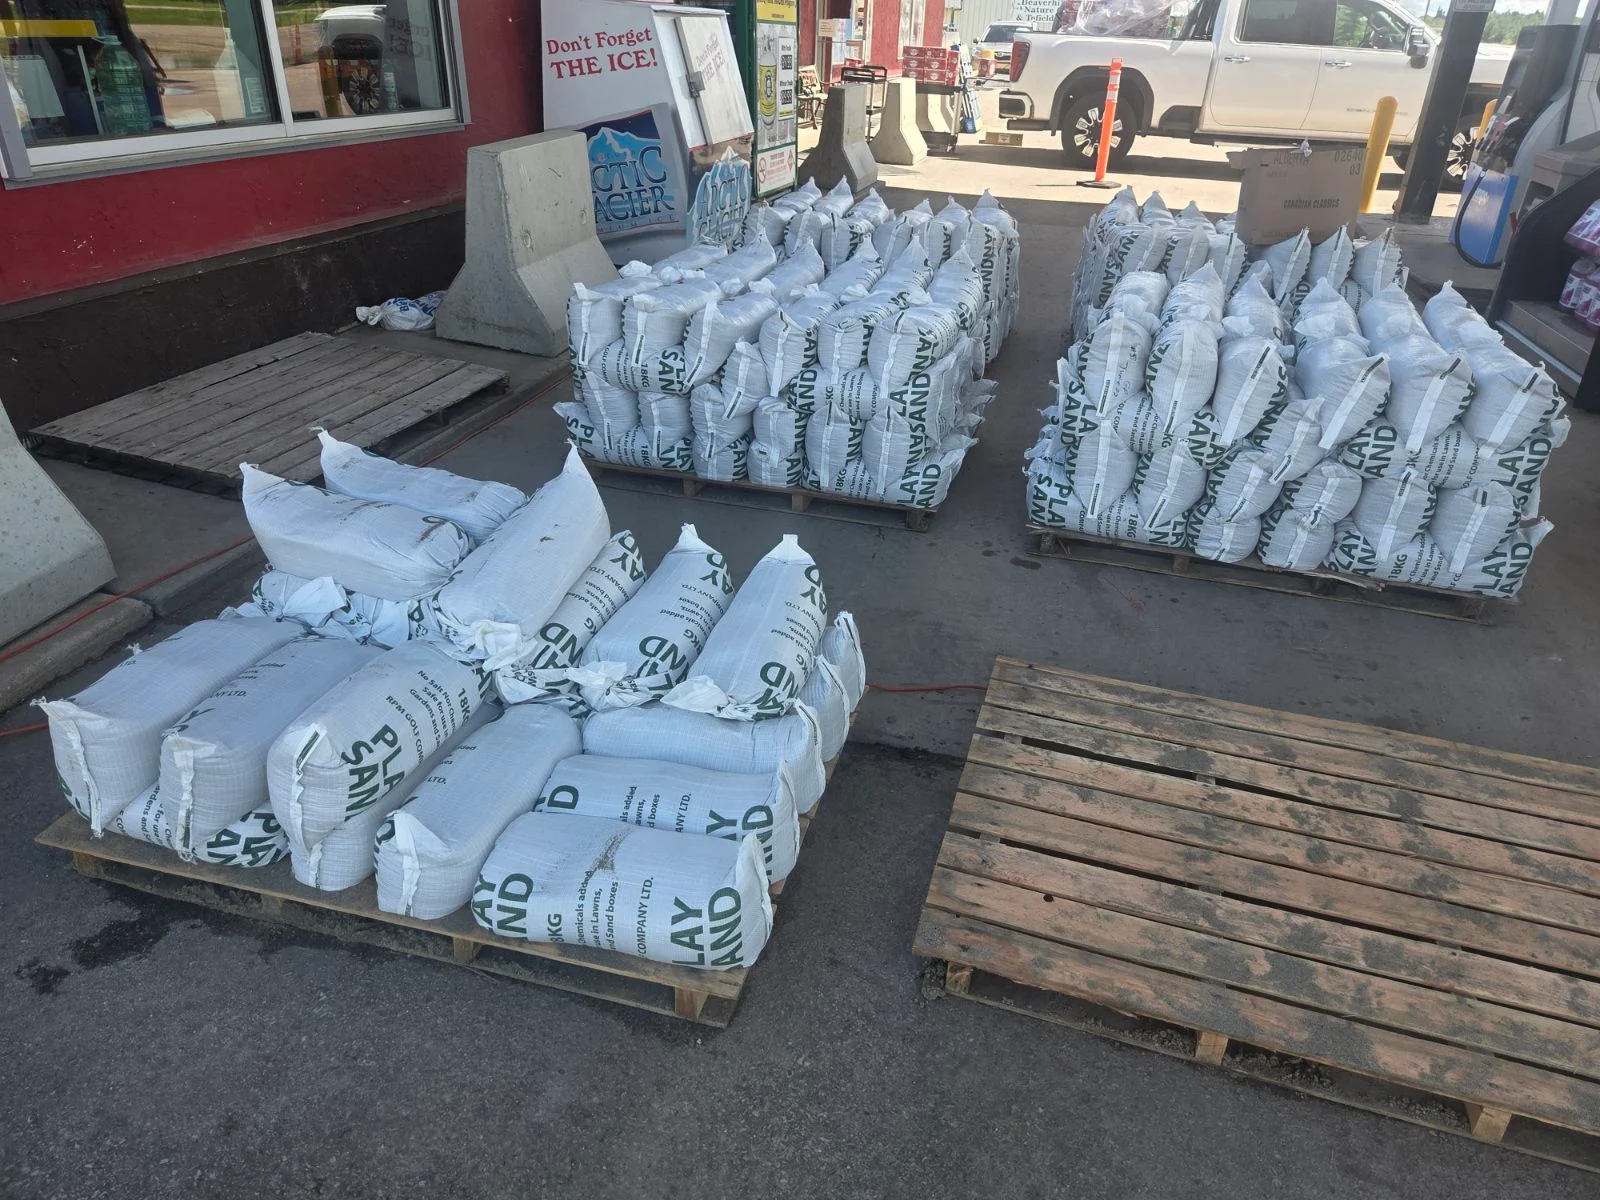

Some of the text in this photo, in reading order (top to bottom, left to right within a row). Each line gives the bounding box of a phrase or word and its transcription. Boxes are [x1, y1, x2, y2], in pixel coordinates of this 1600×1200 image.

[546, 28, 652, 55] Don't Forget
[550, 47, 658, 79] THE ICE!
[592, 146, 667, 192] CTIC
[592, 186, 675, 224] ACIER
[641, 363, 650, 388] 18KG
[658, 350, 679, 393] SAN
[797, 370, 817, 413] AND
[578, 424, 595, 458] PLA
[1188, 410, 1215, 457] SAN
[1364, 425, 1397, 478] AND
[897, 470, 920, 504] LAY
[916, 464, 941, 506] AND
[1031, 473, 1052, 524] SAN
[1048, 483, 1072, 523] PLA
[1127, 514, 1138, 538] 18KG
[609, 552, 645, 582] AY
[701, 570, 733, 596] AY
[1388, 554, 1408, 578] 18KG
[1474, 548, 1507, 591] LAY
[1498, 543, 1532, 595] AND
[660, 609, 685, 619] added
[698, 591, 724, 614] OMPANY
[540, 623, 584, 665] ND
[639, 636, 687, 671] ND
[683, 629, 702, 655] 8KG
[418, 670, 452, 708] No Salt Nor
[422, 686, 438, 702] Safe
[437, 702, 445, 716] for
[386, 695, 406, 714] RPM
[405, 713, 420, 737] GOLF
[409, 688, 435, 719] Gardens
[431, 719, 439, 735] and
[341, 740, 380, 815] SAN
[370, 724, 405, 800] PLA
[428, 776, 447, 785] LTD.
[142, 782, 161, 816] ardens
[624, 786, 637, 811] added
[635, 799, 646, 826] awns,
[648, 794, 660, 821] boxes
[681, 793, 692, 814] LTD.
[471, 873, 497, 932] AY
[497, 873, 534, 935] ND
[591, 888, 603, 927] Lawns,
[606, 881, 619, 938] Sand boxes
[636, 877, 654, 955] COMPANY LTD.
[548, 913, 565, 943] 8KG
[575, 904, 586, 943] emicals
[670, 896, 705, 965] LAY
[708, 887, 743, 966] AND
